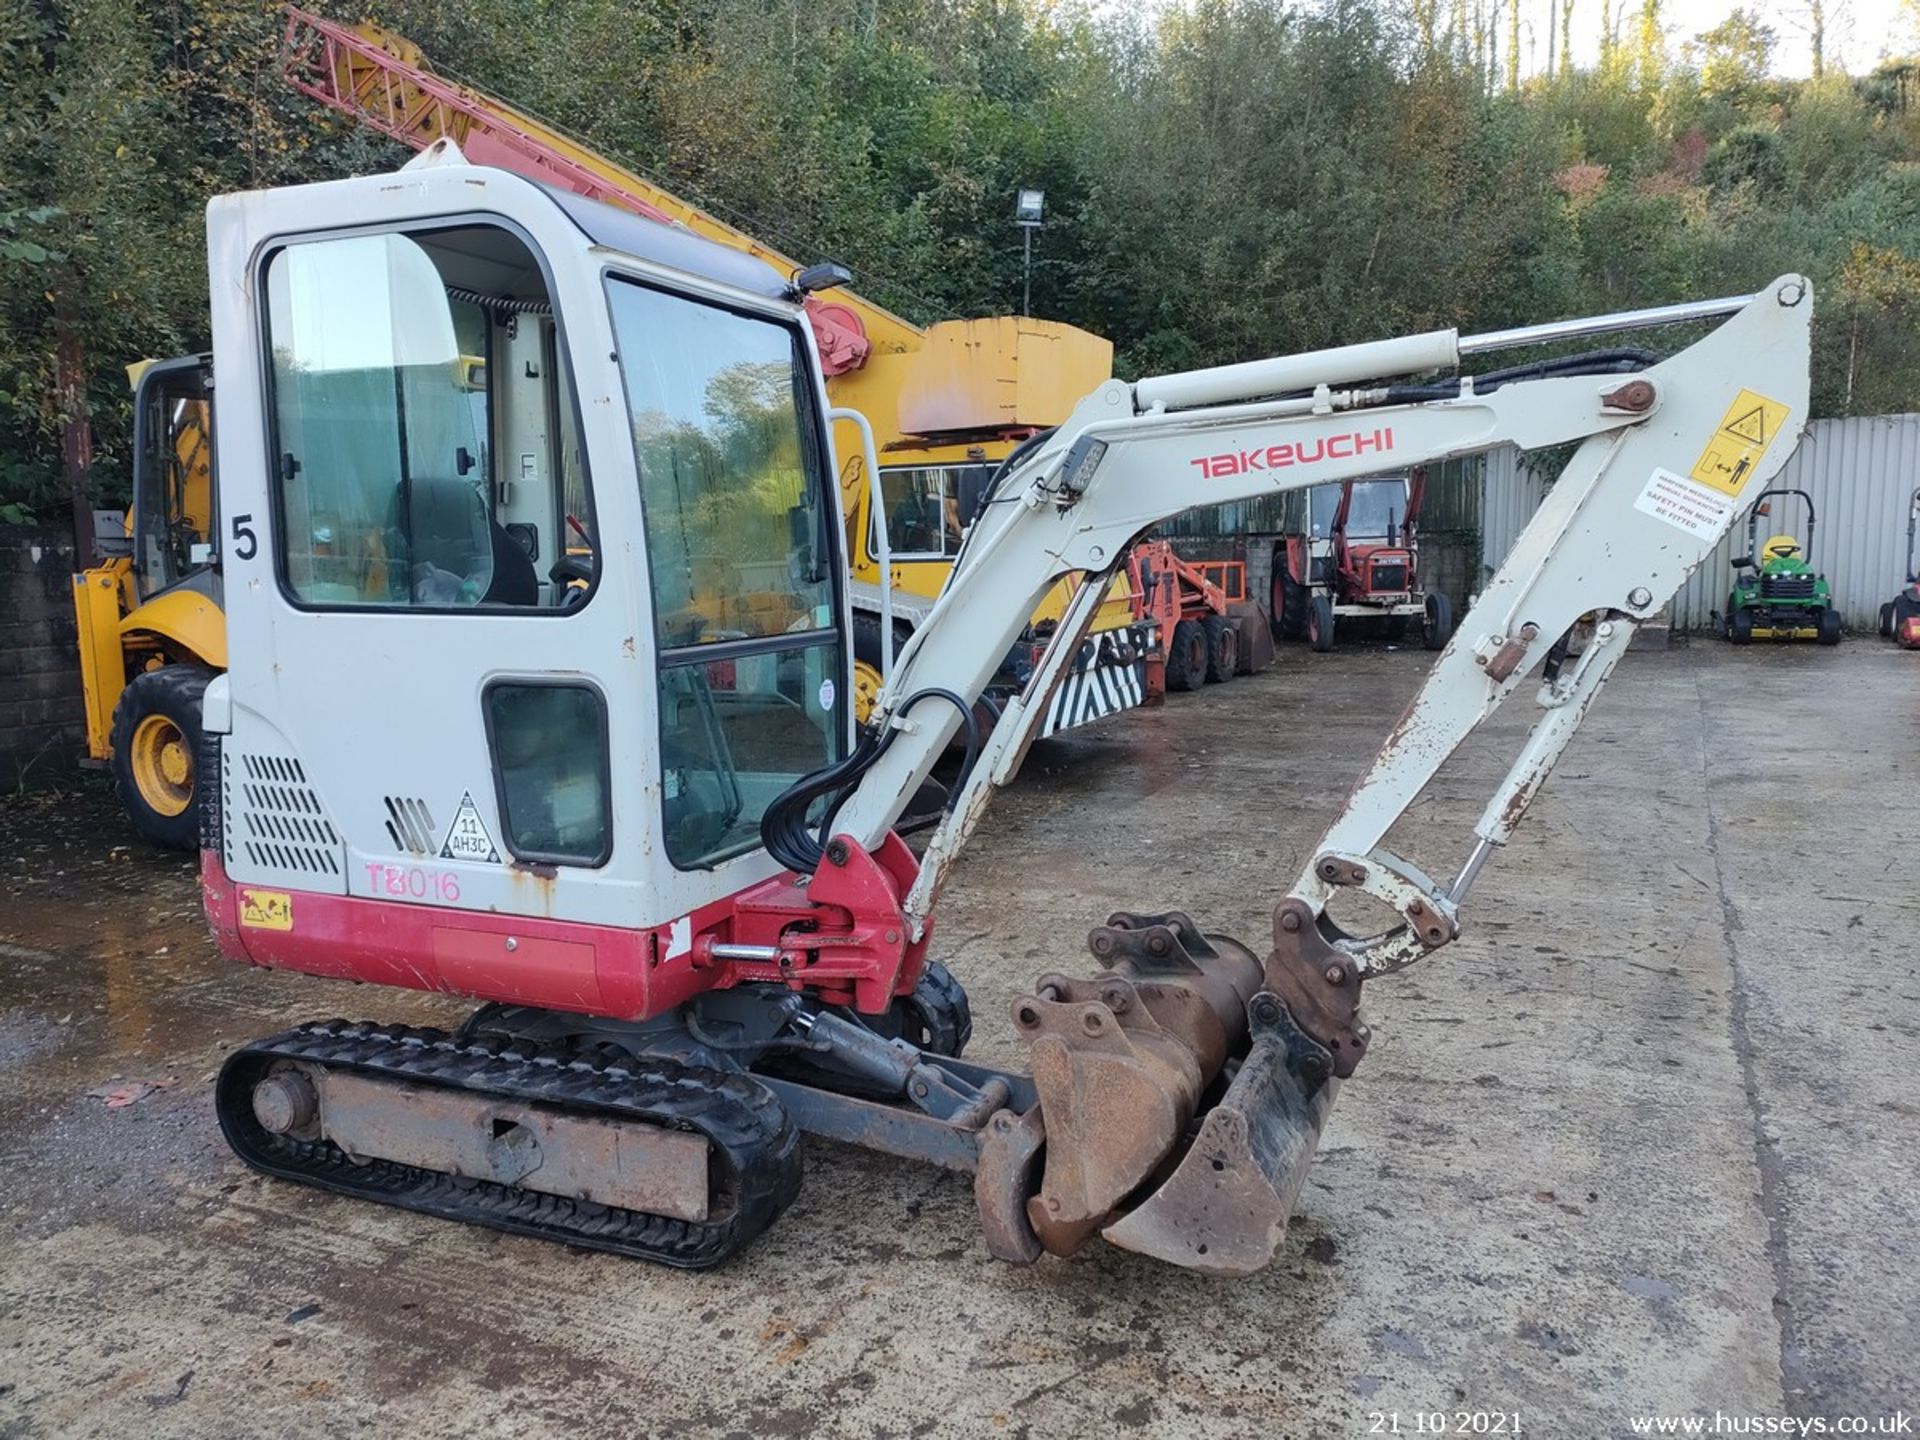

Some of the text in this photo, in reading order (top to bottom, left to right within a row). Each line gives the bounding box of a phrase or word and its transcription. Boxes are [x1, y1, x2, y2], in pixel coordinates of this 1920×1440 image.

[521, 454, 535, 479] F
[1190, 427, 1394, 479] TAKEUCHI
[1646, 491, 1718, 526] SAFETY PIN MUST
[1655, 506, 1697, 529] BE FITTED
[232, 513, 258, 561] 5
[461, 818, 477, 834] 11
[452, 835, 487, 854] AH3C
[364, 863, 461, 902] TB016
